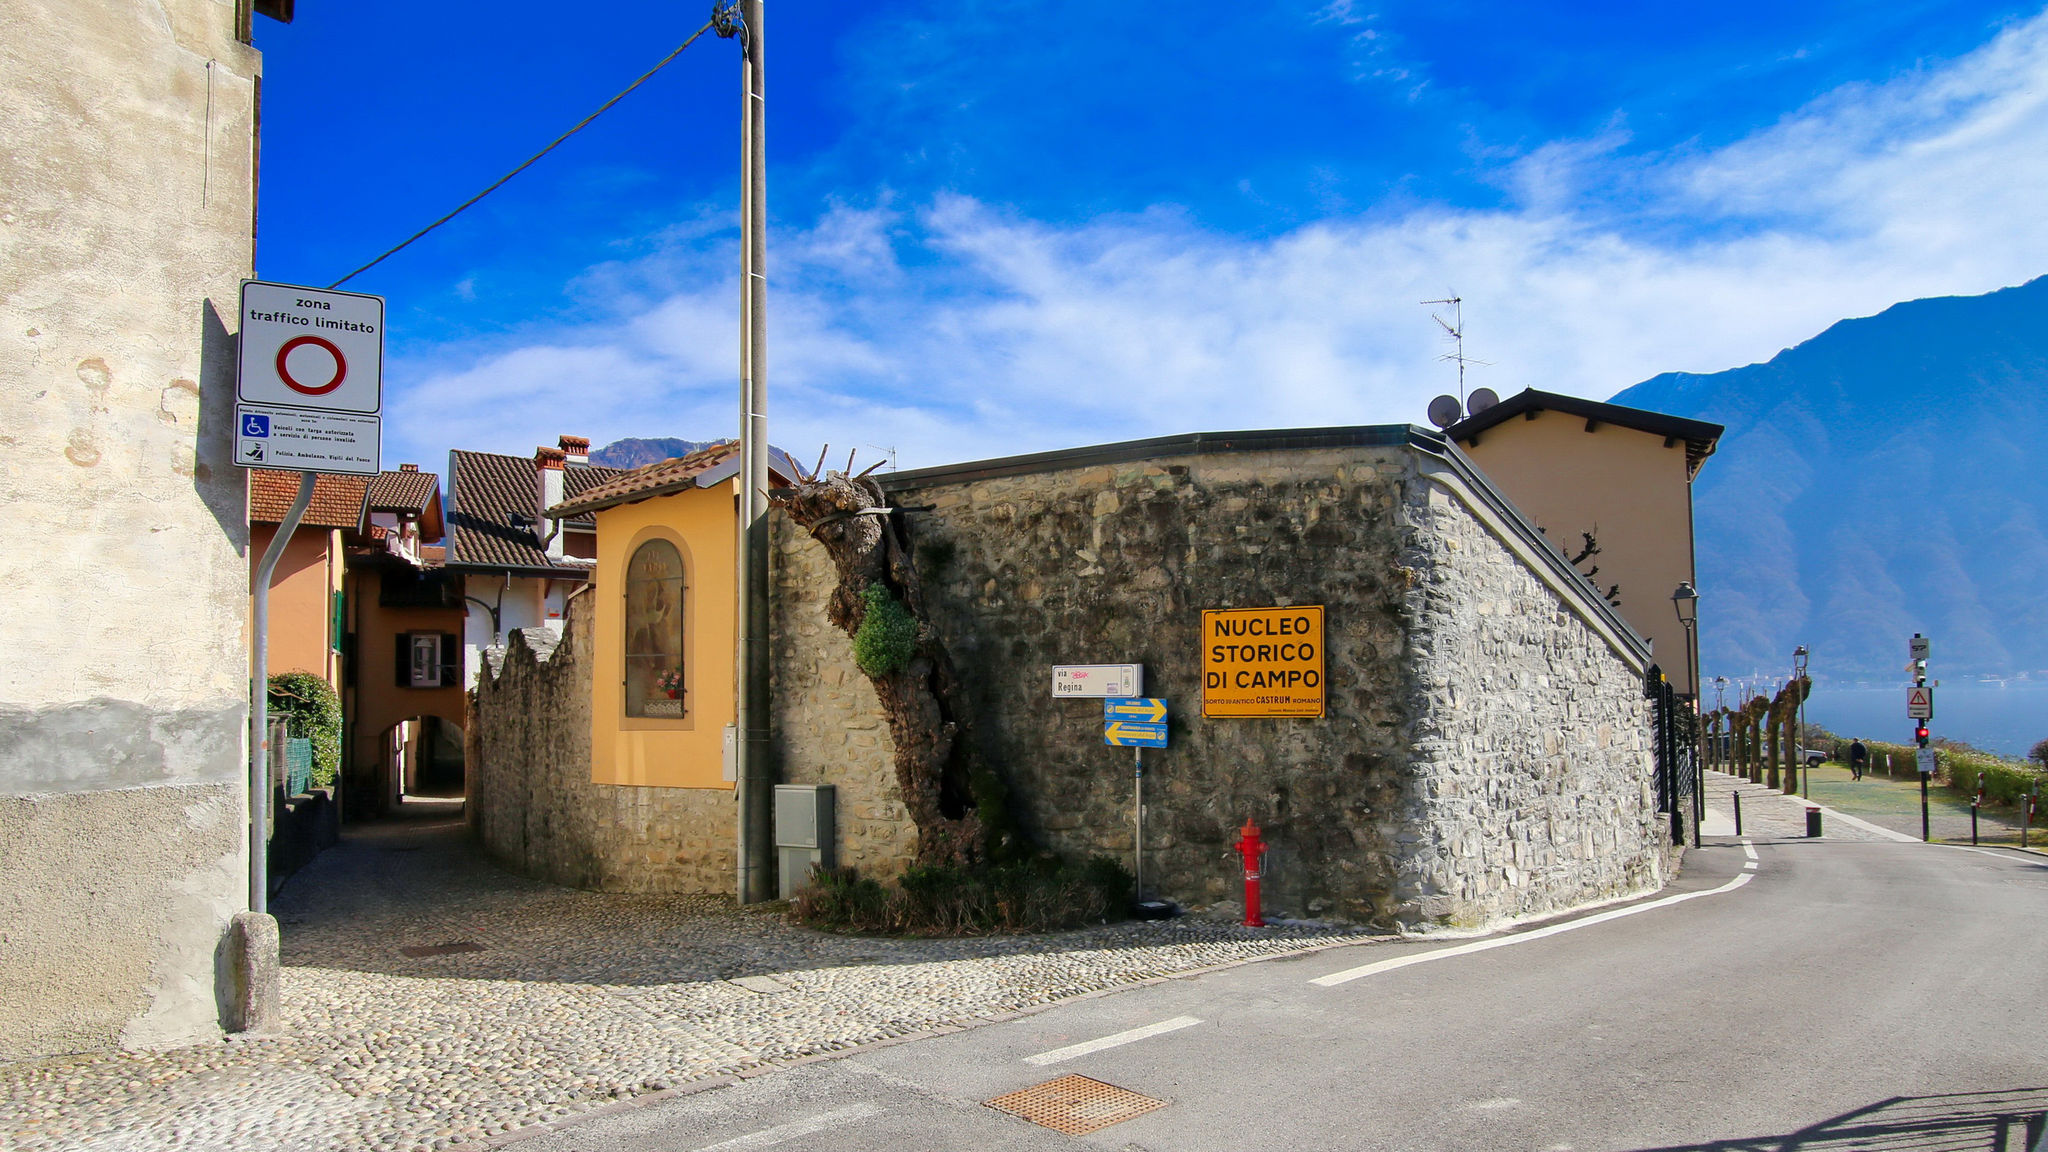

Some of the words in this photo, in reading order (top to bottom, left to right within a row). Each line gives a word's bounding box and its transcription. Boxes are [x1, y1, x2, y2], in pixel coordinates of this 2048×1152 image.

[296, 298, 331, 310] zona
[250, 309, 309, 326] traffico
[315, 317, 375, 334] limitato
[1215, 616, 1310, 637] NUCLEO
[1211, 642, 1315, 663] STORICO
[1057, 668, 1067, 678] via
[1206, 671, 1227, 689] DI
[1235, 669, 1320, 689] CAMPO
[1057, 682, 1083, 693] Regina
[1256, 695, 1291, 704] CASTRUM
